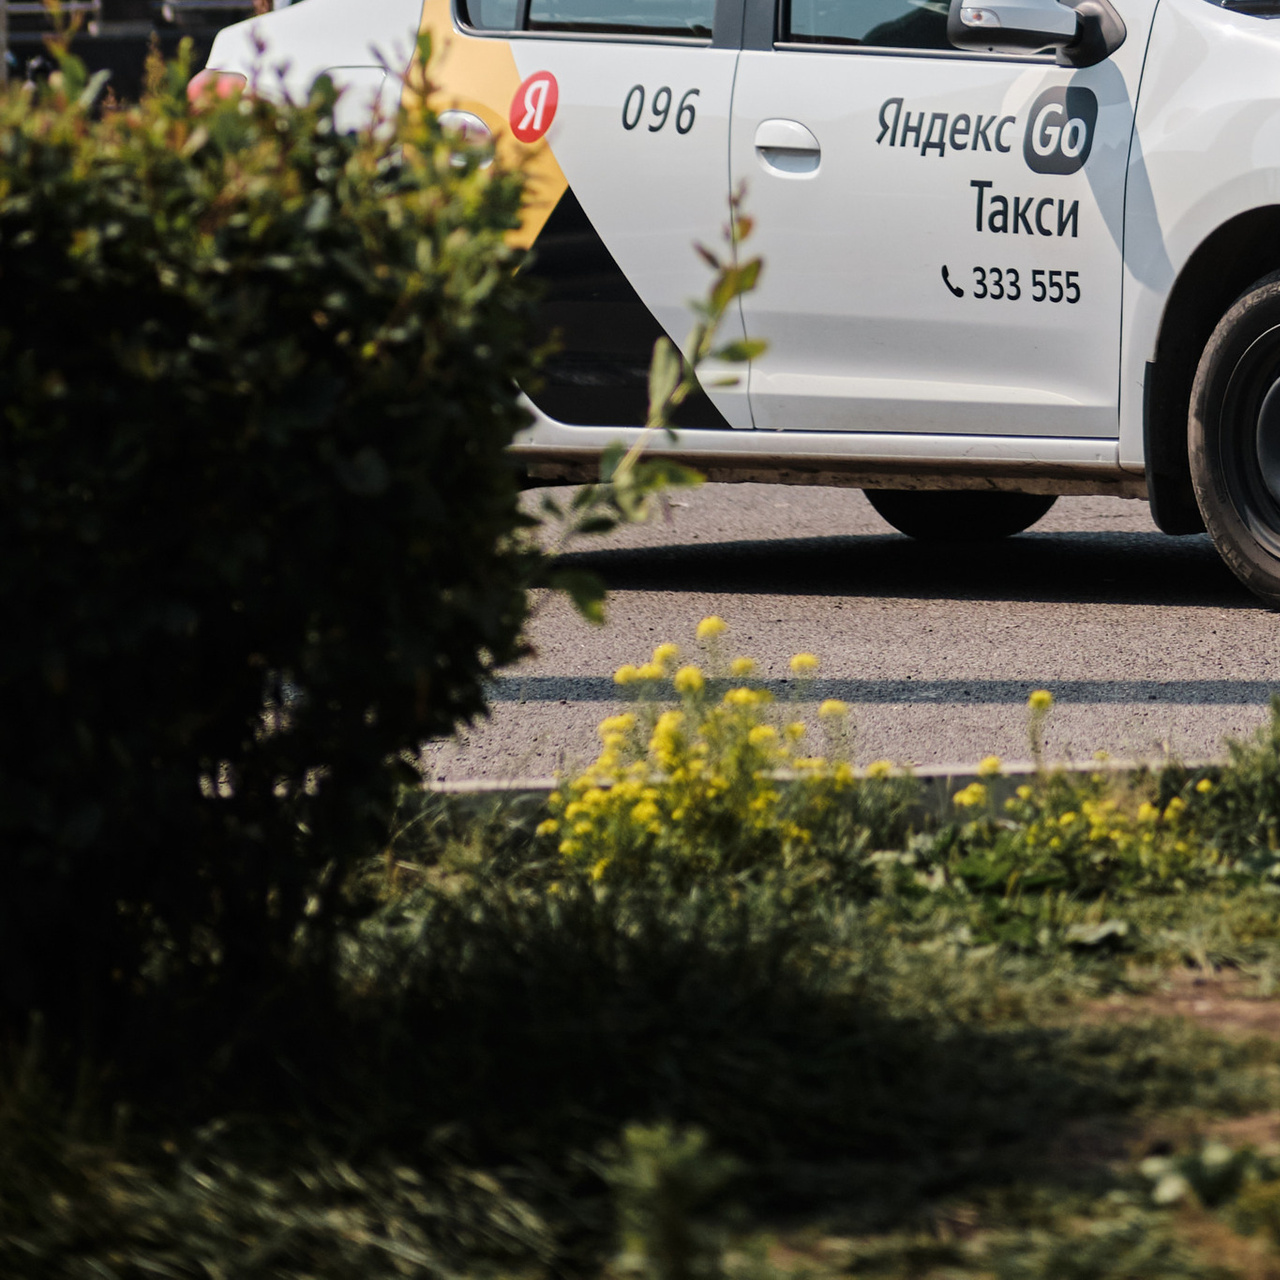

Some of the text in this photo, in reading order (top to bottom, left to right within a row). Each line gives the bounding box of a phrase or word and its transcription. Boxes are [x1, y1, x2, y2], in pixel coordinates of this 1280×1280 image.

[517, 79, 550, 131] Я
[621, 83, 701, 135] 096
[875, 97, 1088, 158] Яндекс Go
[970, 180, 1079, 238] Такси
[972, 266, 1081, 304] 333 555
